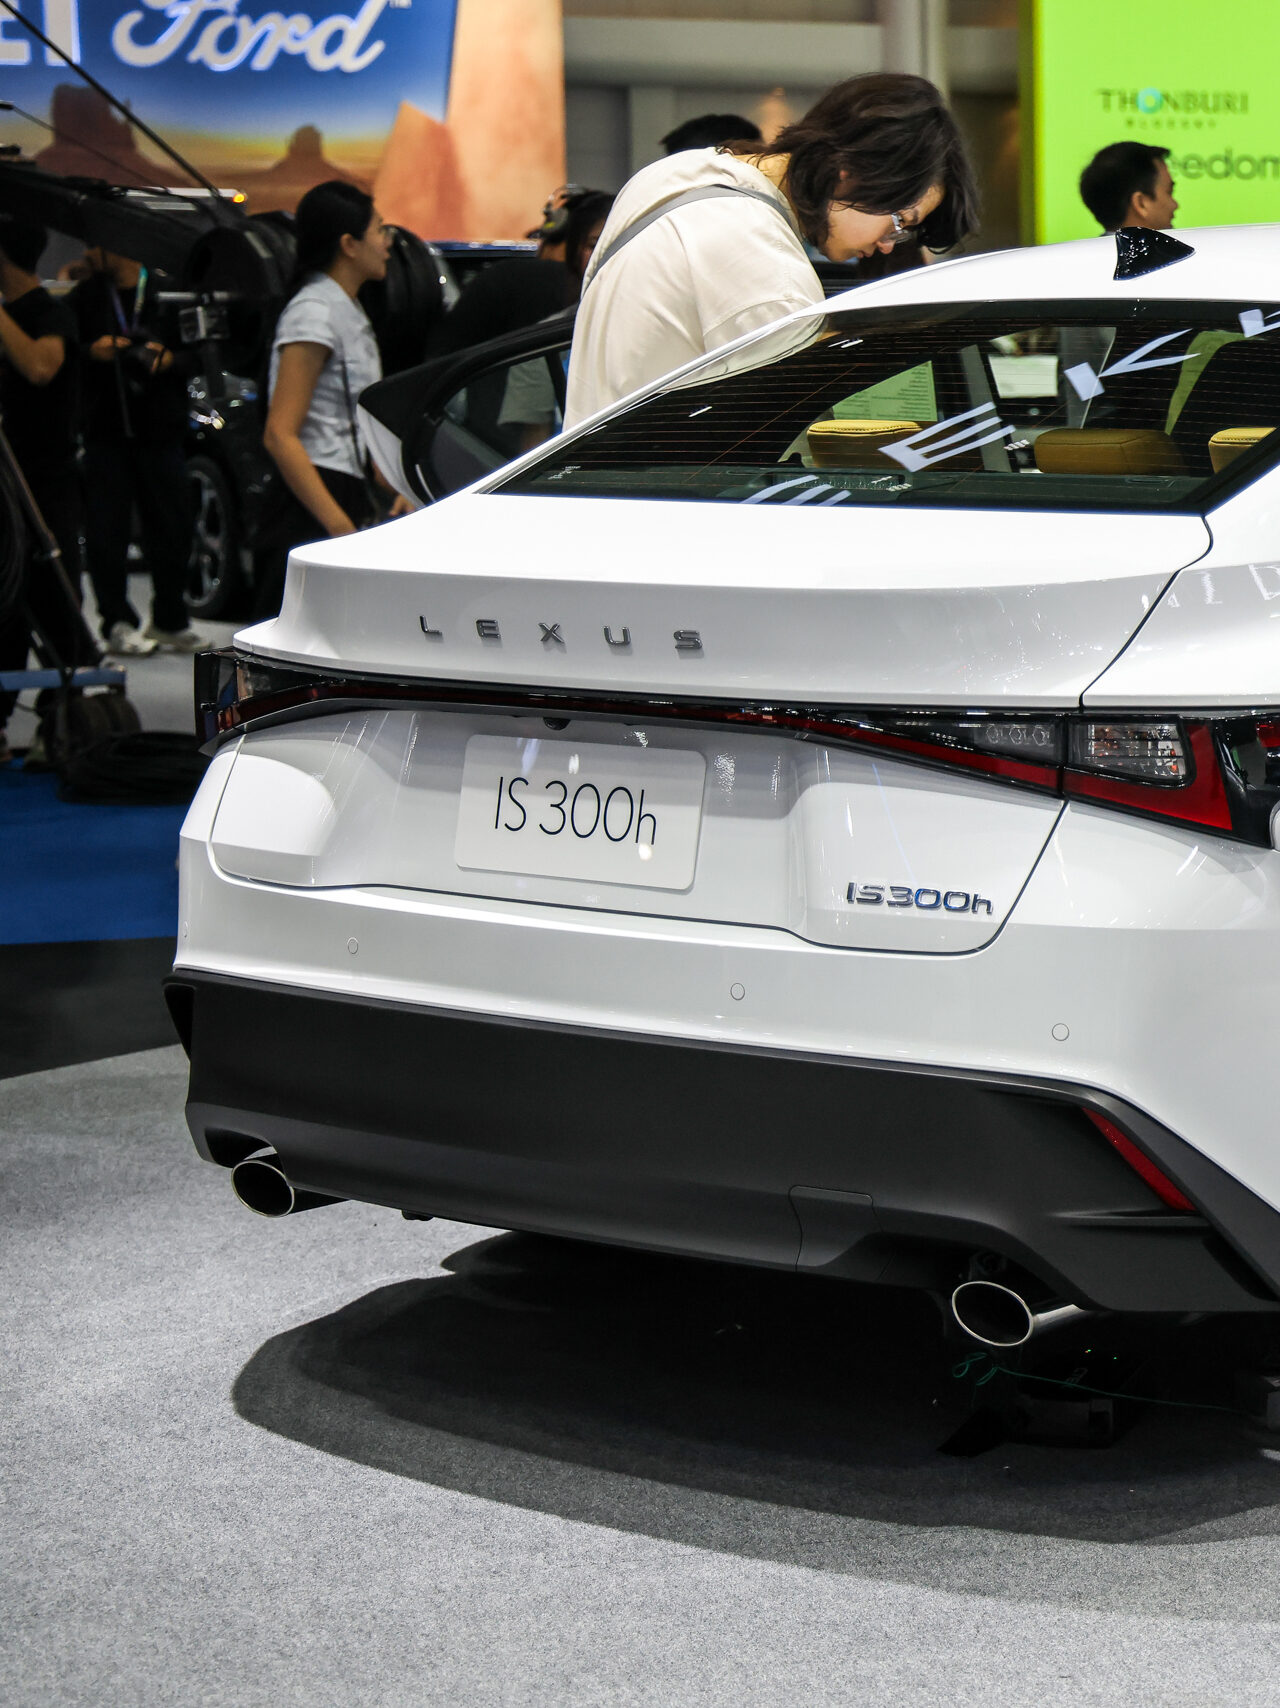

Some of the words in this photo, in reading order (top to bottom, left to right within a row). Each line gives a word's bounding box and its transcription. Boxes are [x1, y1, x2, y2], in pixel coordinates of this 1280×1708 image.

[111, 0, 388, 73] Ford
[1098, 87, 1249, 114] THONBURI
[419, 614, 702, 649] LEXUS
[495, 776, 530, 832] IS
[539, 780, 657, 846] 300h
